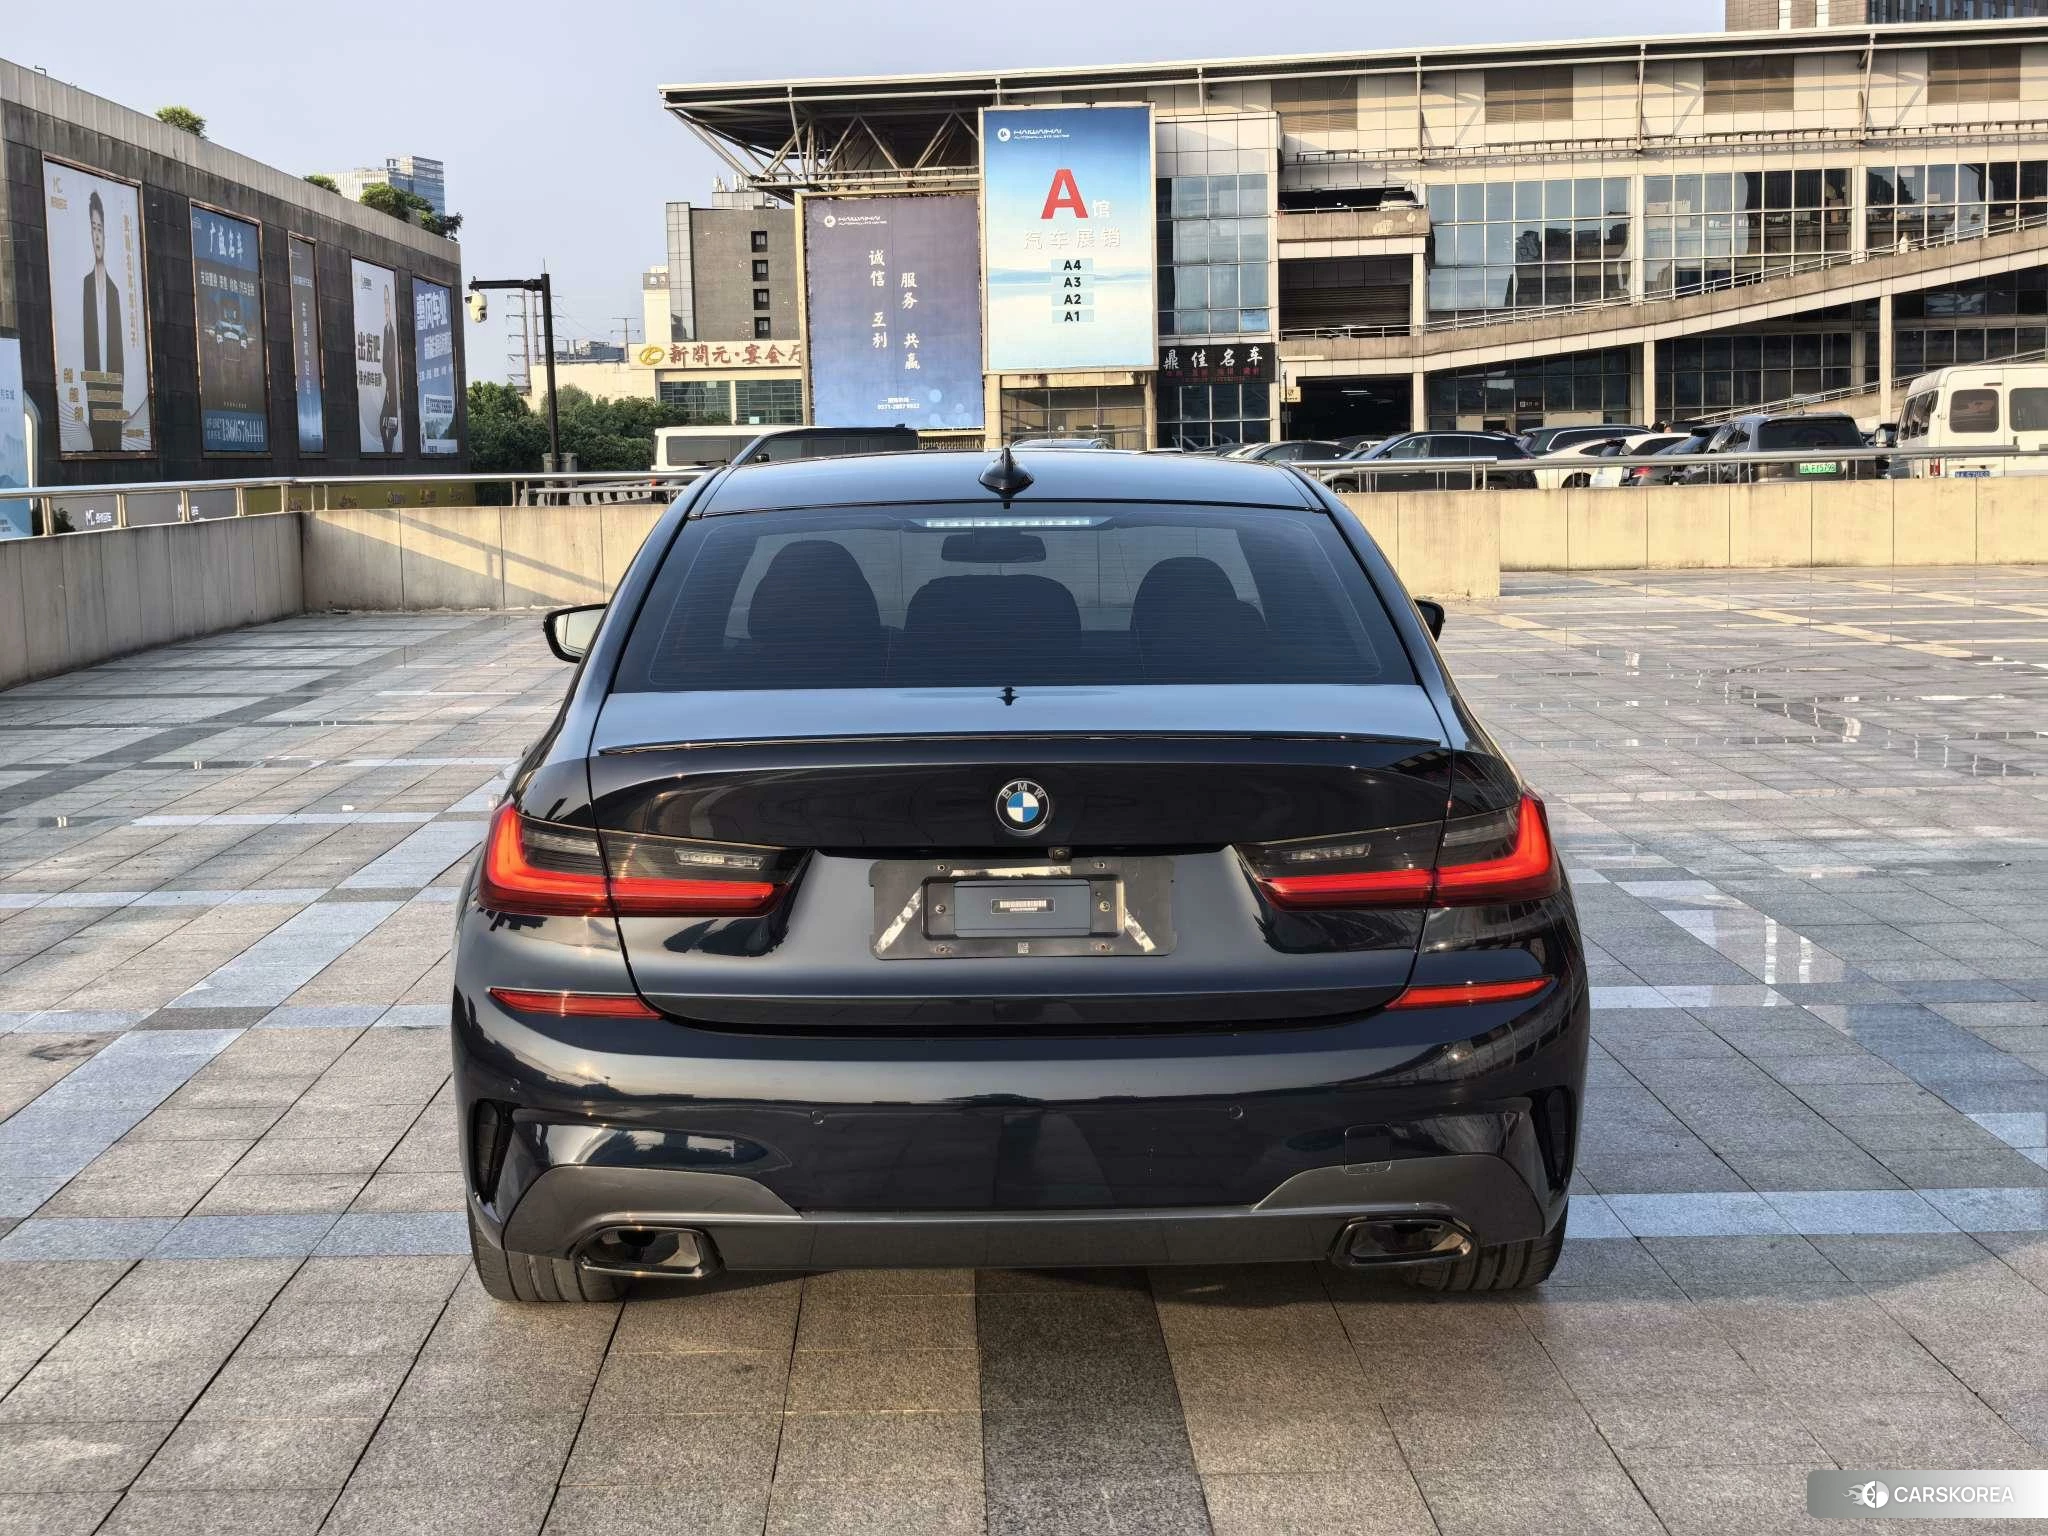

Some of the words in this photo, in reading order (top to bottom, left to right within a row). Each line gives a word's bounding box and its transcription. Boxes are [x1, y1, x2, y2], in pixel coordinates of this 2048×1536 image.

[1041, 168, 1089, 219] A
[1024, 226, 1121, 249] 汽车展销
[1063, 259, 1082, 271] A4
[1063, 276, 1082, 288] A3
[1063, 293, 1082, 305] A2
[1063, 311, 1080, 322] A1
[1001, 782, 1045, 800] BMW
